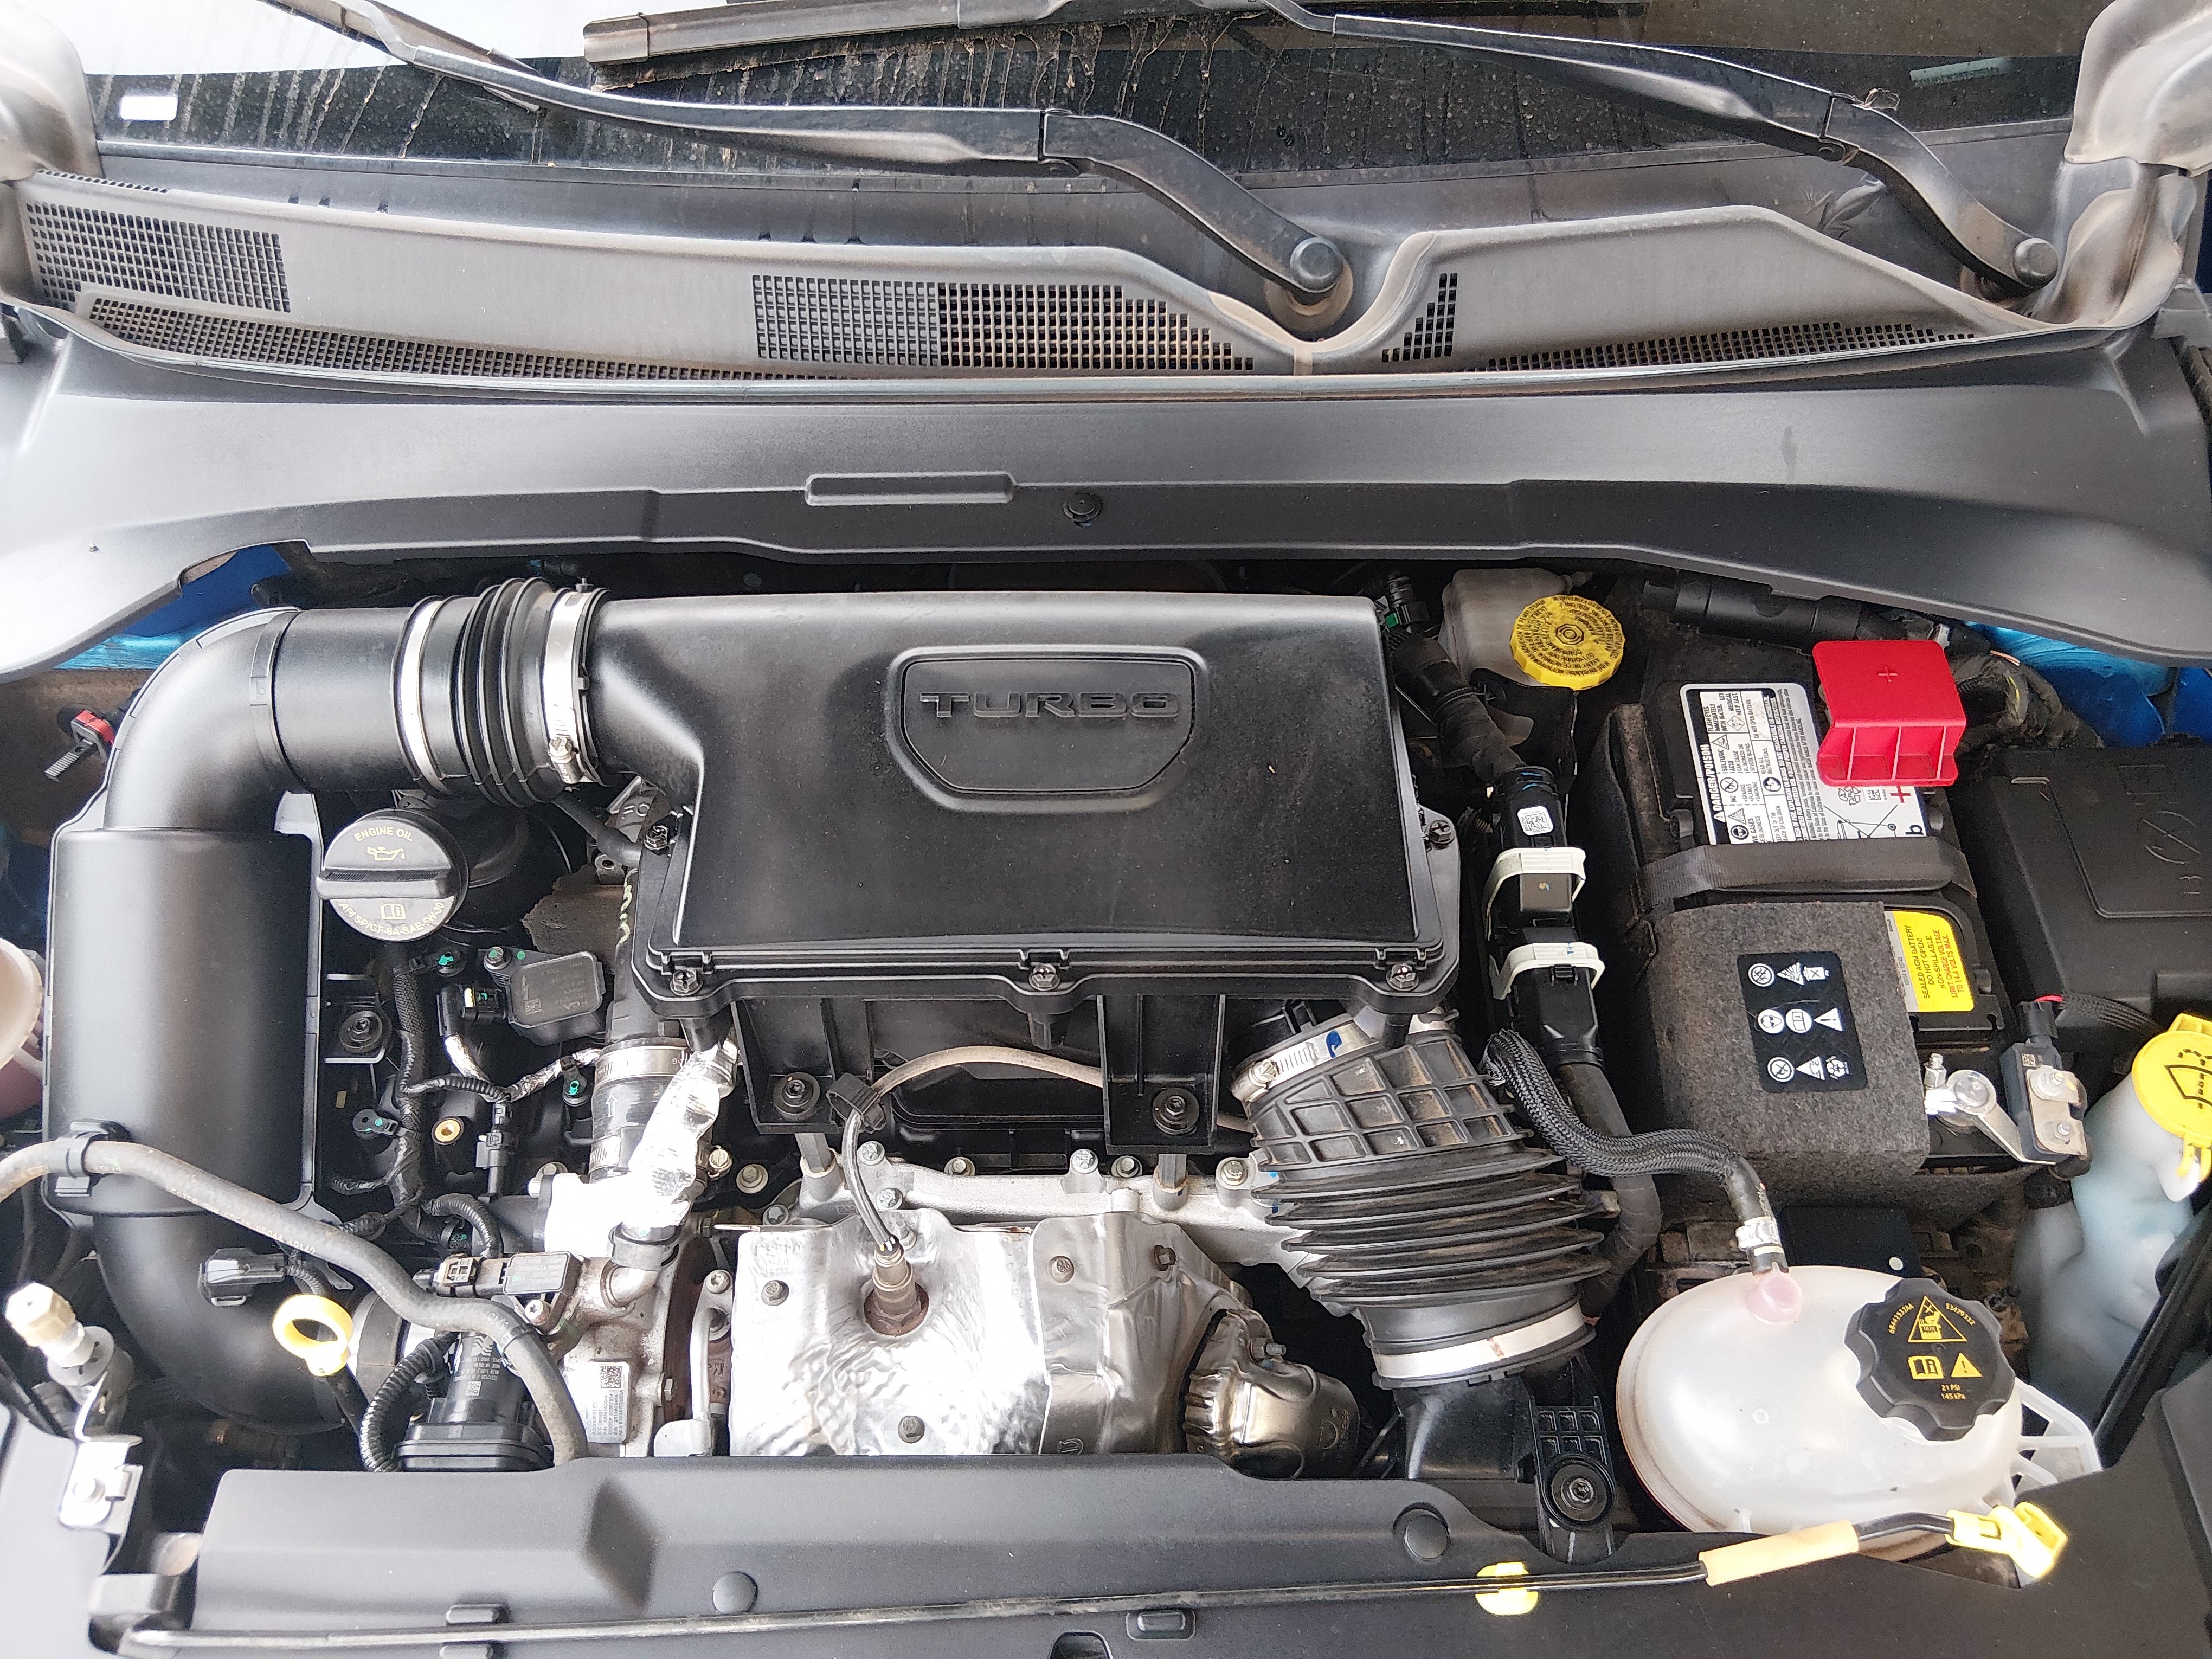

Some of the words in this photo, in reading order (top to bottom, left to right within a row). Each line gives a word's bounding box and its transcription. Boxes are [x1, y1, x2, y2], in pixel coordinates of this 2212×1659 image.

[919, 691, 1179, 718] TURBO
[1725, 693, 1734, 711] MEDICAL
[1734, 705, 1742, 715] HELP
[1706, 718, 1714, 731] FLUSH
[1709, 703, 1721, 731] IMMEDIATELY
[1776, 725, 1786, 744] CHARGING
[1717, 749, 1728, 770] SULFURIC
[1739, 750, 1748, 771] BLINDNESS
[1781, 745, 1790, 761] PROPER
[1727, 760, 1735, 771] ACID
[1747, 757, 1756, 771] SEVERE
[1785, 761, 1794, 777] FOLLOW
[1699, 744, 1723, 811] DANGER/POISON
[1740, 783, 1748, 799] SPARKS
[1746, 783, 1754, 799] FLAMES
[1752, 781, 1760, 799] SMOKING
[1784, 787, 1795, 810] EXPLOSION
[1791, 787, 1801, 806] INVERTED
[354, 827, 394, 842] ENGINE
[396, 828, 413, 842] OIL
[1747, 818, 1756, 833] GASES
[1754, 816, 1764, 837] BLINDNESS
[339, 903, 356, 918] API
[1904, 925, 1917, 953] BATTERY
[1916, 938, 1927, 957] OPEN!
[1932, 929, 1945, 955] VOLTAGE
[1912, 955, 1922, 970] AGM
[1922, 960, 1931, 973] NOT
[1925, 936, 1946, 988] NON-SPILLABLE
[1940, 956, 1953, 979] CHARGE
[1946, 950, 1957, 968] VOLTS
[1926, 975, 1934, 984] DO
[1952, 970, 1961, 982] 14.4
[1917, 973, 1930, 998] SEALED
[1947, 982, 1958, 997] LIMIT
